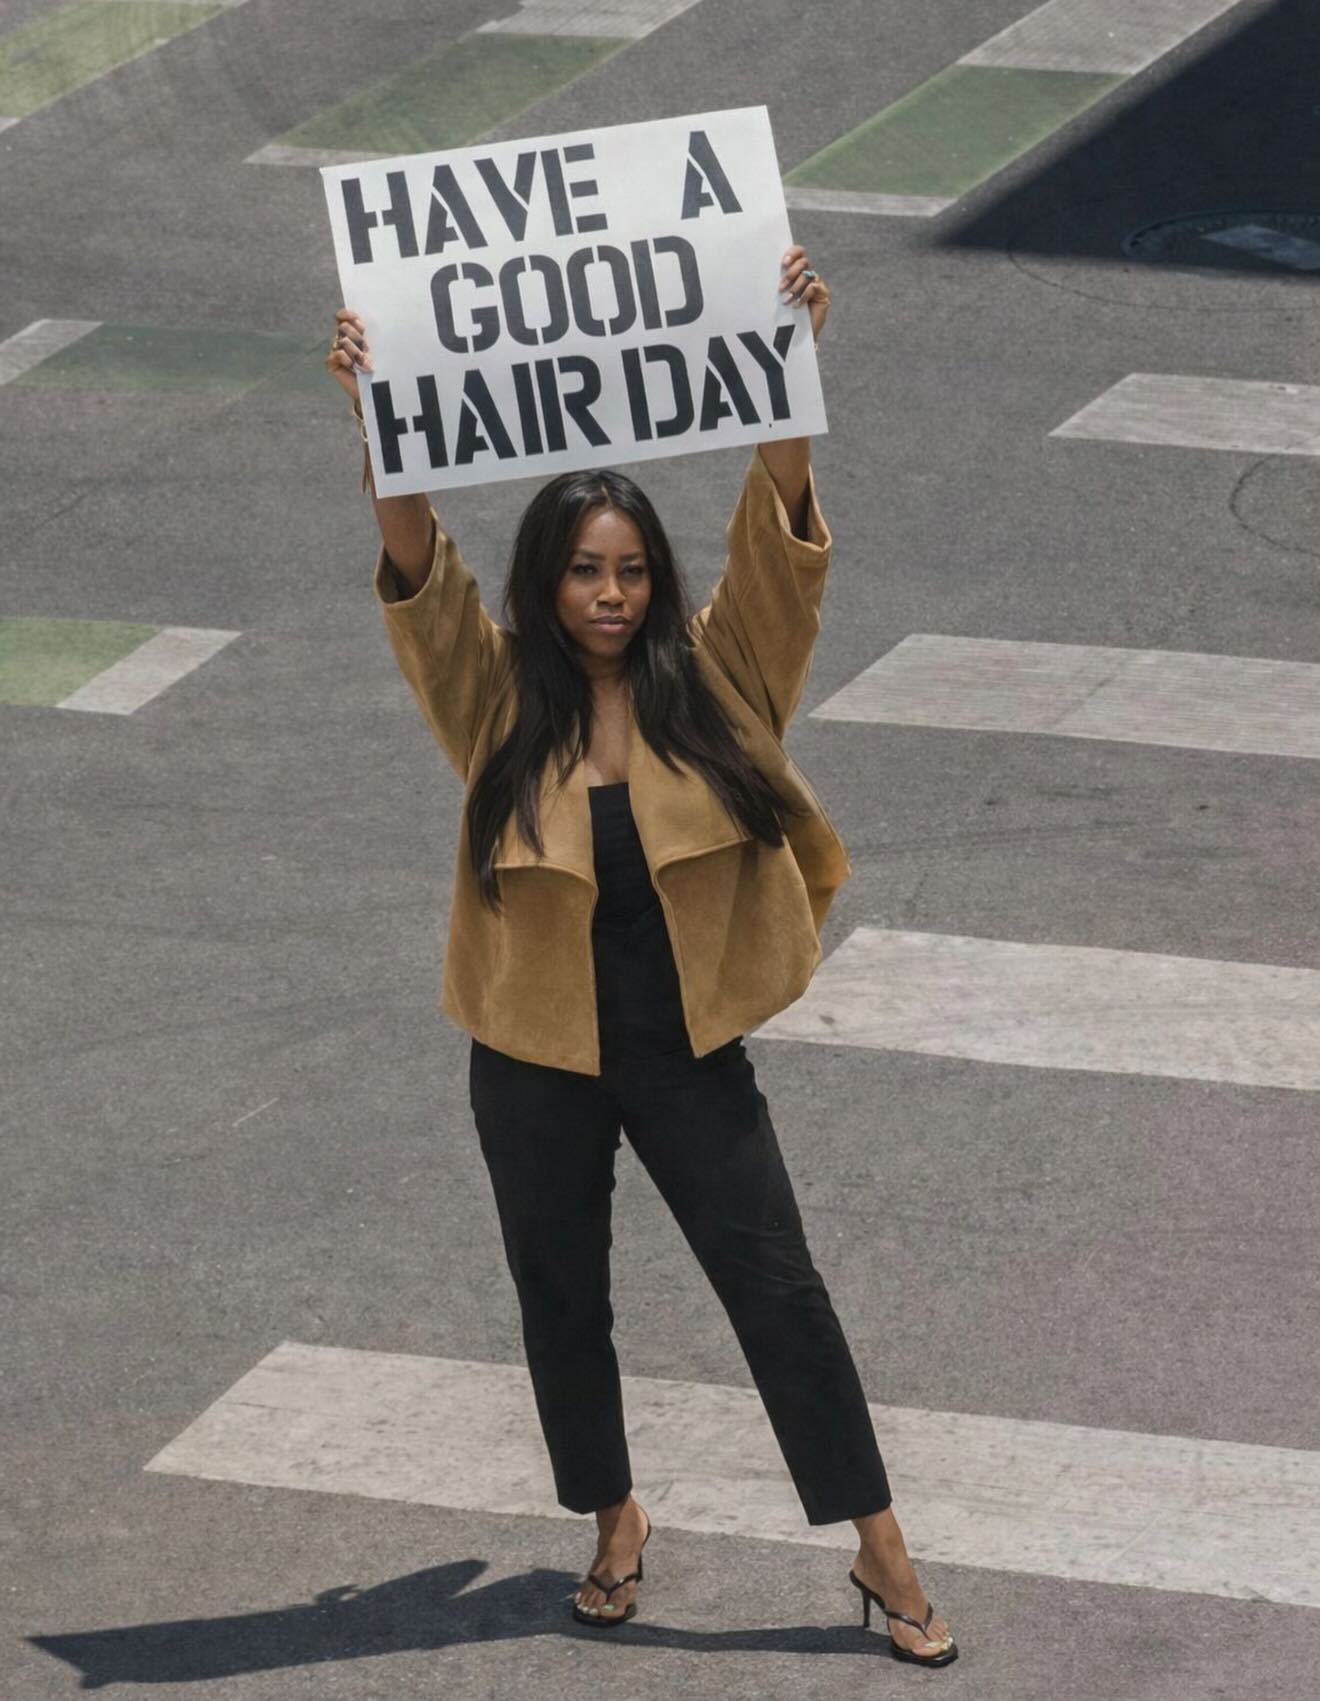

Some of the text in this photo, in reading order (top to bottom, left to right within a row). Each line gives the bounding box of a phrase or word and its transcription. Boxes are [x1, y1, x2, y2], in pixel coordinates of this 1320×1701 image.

[340, 130, 743, 265] HAVE A
[430, 235, 704, 354] GOOD
[370, 324, 796, 475] HAIR DAY
